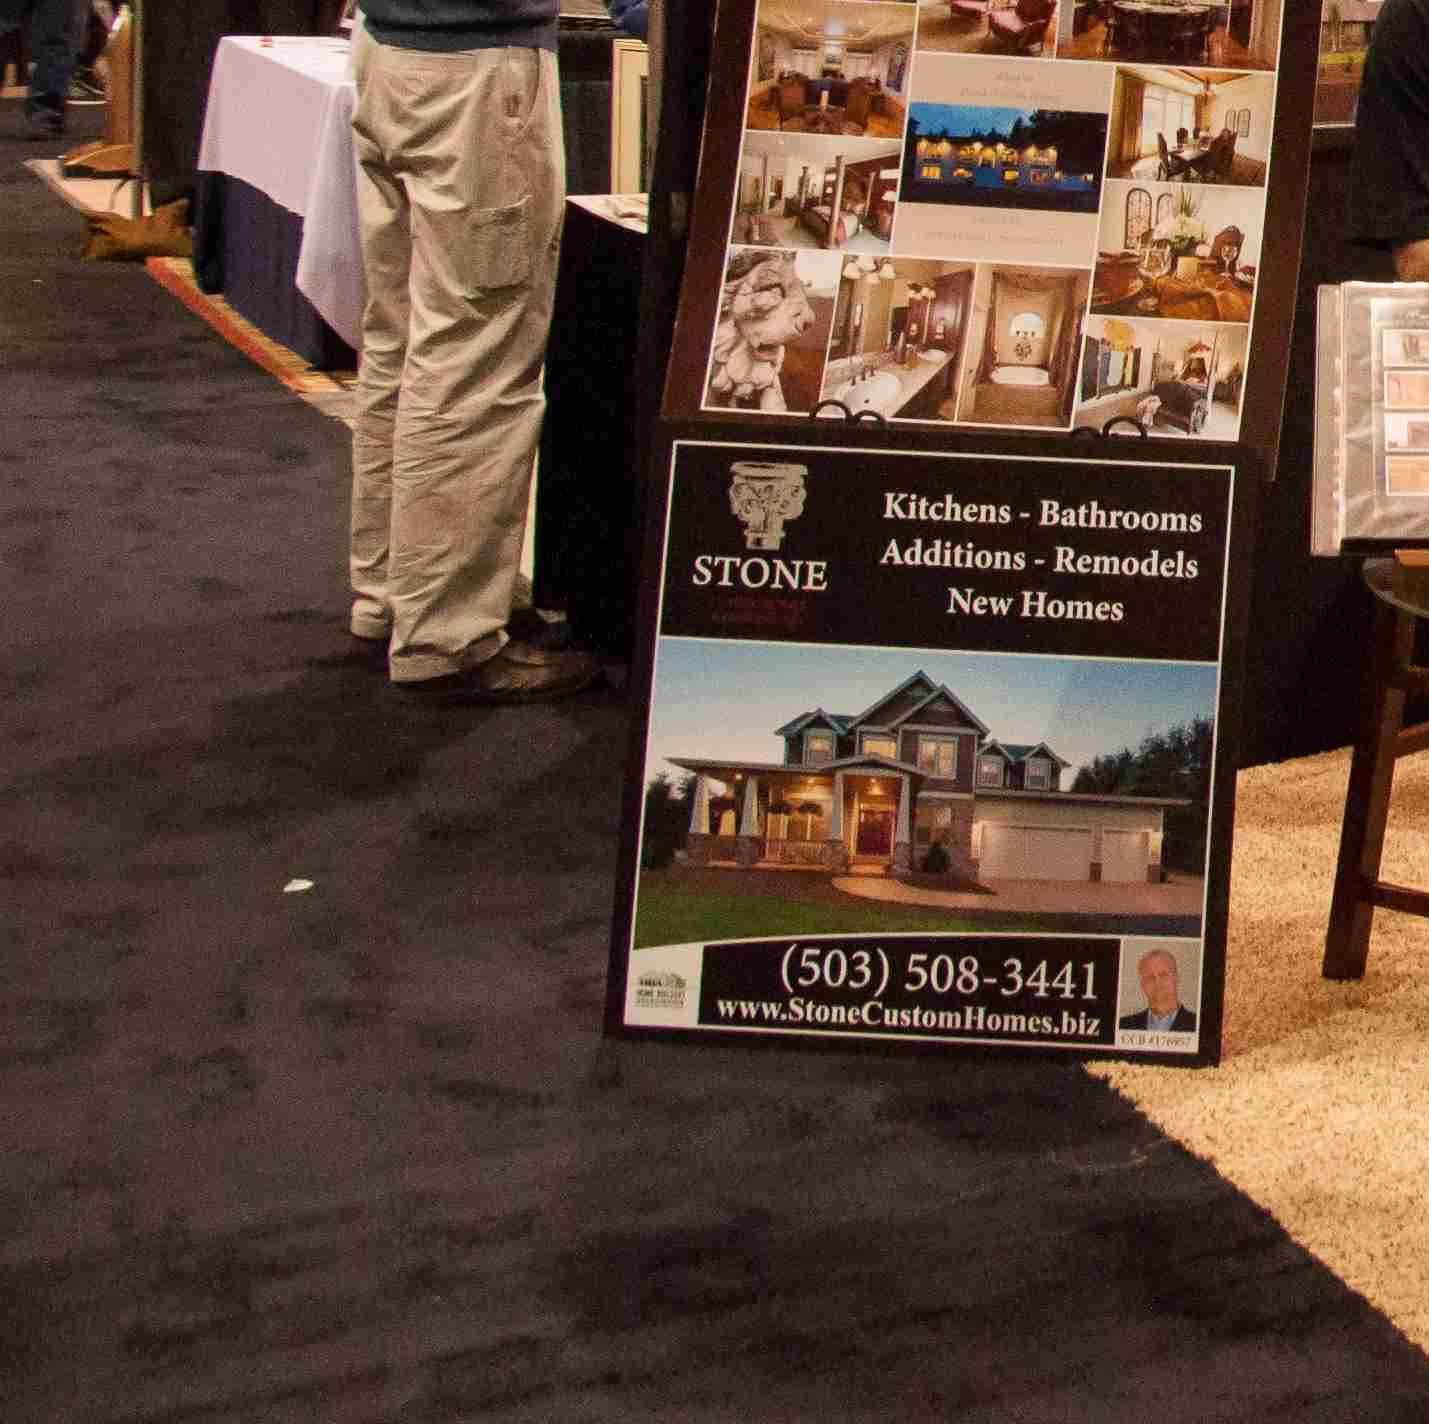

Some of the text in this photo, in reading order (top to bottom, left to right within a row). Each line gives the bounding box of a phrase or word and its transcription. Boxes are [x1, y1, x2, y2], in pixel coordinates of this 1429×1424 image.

[883, 492, 1011, 524] Kitchens
[1039, 498, 1203, 533] Bathrooms
[691, 555, 829, 591] STONE
[880, 538, 1026, 572] Additions
[1053, 546, 1199, 579] Remodels
[947, 586, 1124, 622] New Homes
[780, 943, 1098, 1000] (503) 508-3441
[716, 997, 1101, 1038] www.StoneCustomHomes.biz
